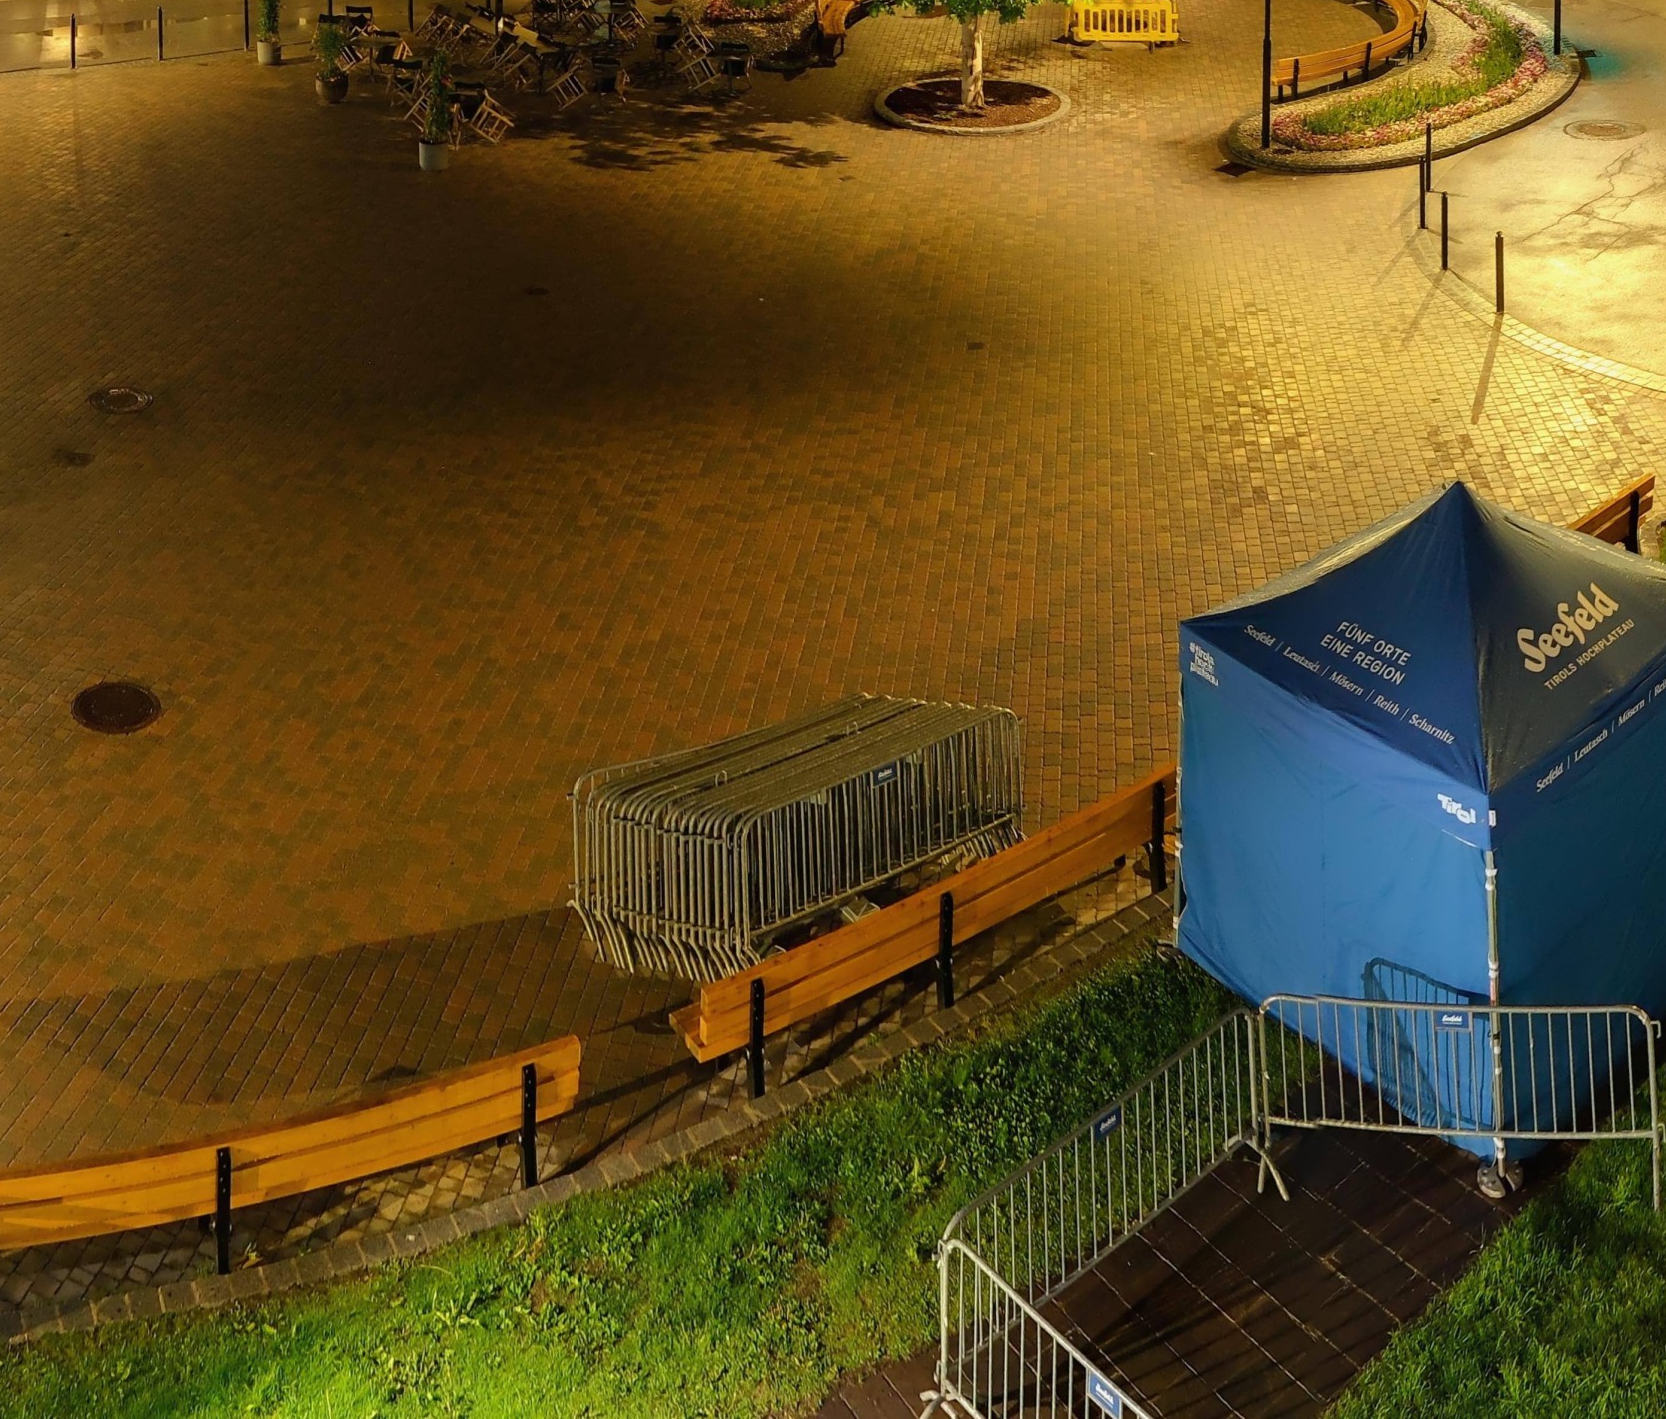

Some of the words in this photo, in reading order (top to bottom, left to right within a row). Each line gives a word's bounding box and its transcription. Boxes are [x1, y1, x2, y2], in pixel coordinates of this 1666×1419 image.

[1336, 621, 1372, 646] FÜNF
[1373, 639, 1412, 666] ORTE
[1517, 582, 1620, 673] Seefeld
[1543, 662, 1578, 691] TIROLS
[1576, 617, 1635, 668] HOCHPLATEAU
[1244, 624, 1276, 647] Seefeld
[1328, 670, 1364, 697] Mösern
[1373, 694, 1400, 717] Reith
[1408, 713, 1455, 745] Scharnitz
[1320, 633, 1354, 662] EINE
[1352, 650, 1406, 686] REGION
[1536, 763, 1564, 793] Seefeld
[1437, 793, 1476, 824] Tirol
